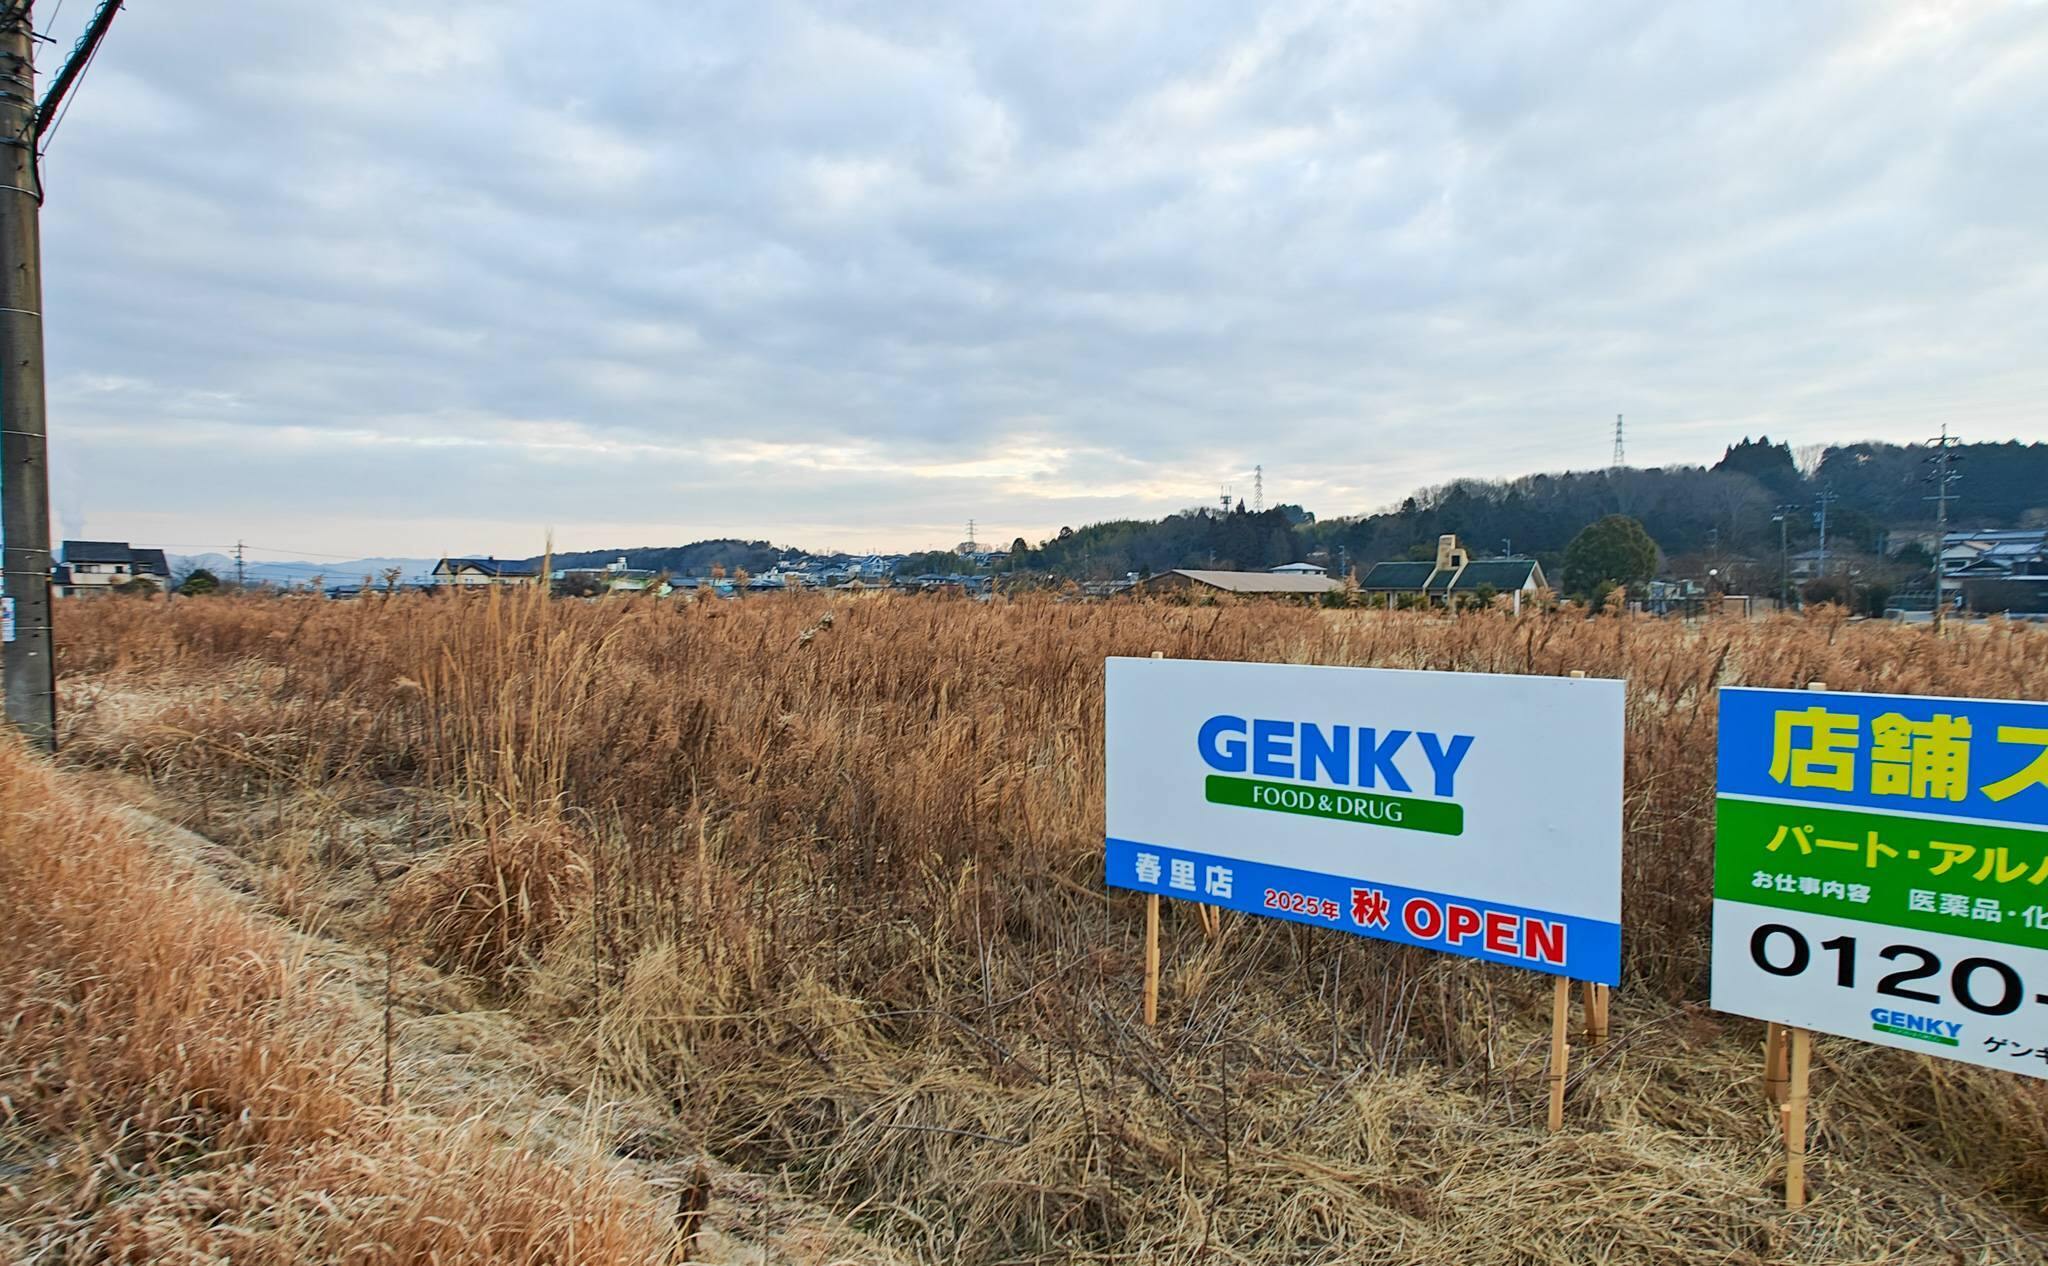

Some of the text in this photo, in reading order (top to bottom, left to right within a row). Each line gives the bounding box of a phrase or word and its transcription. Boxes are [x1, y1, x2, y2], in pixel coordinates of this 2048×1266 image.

[1198, 715, 1475, 797] GENKY
[1136, 852, 1567, 966] 春里店 2025年 秋 OPEN
[1752, 870, 1871, 904] お仕事内容
[1870, 1008, 1963, 1038] GENKY
